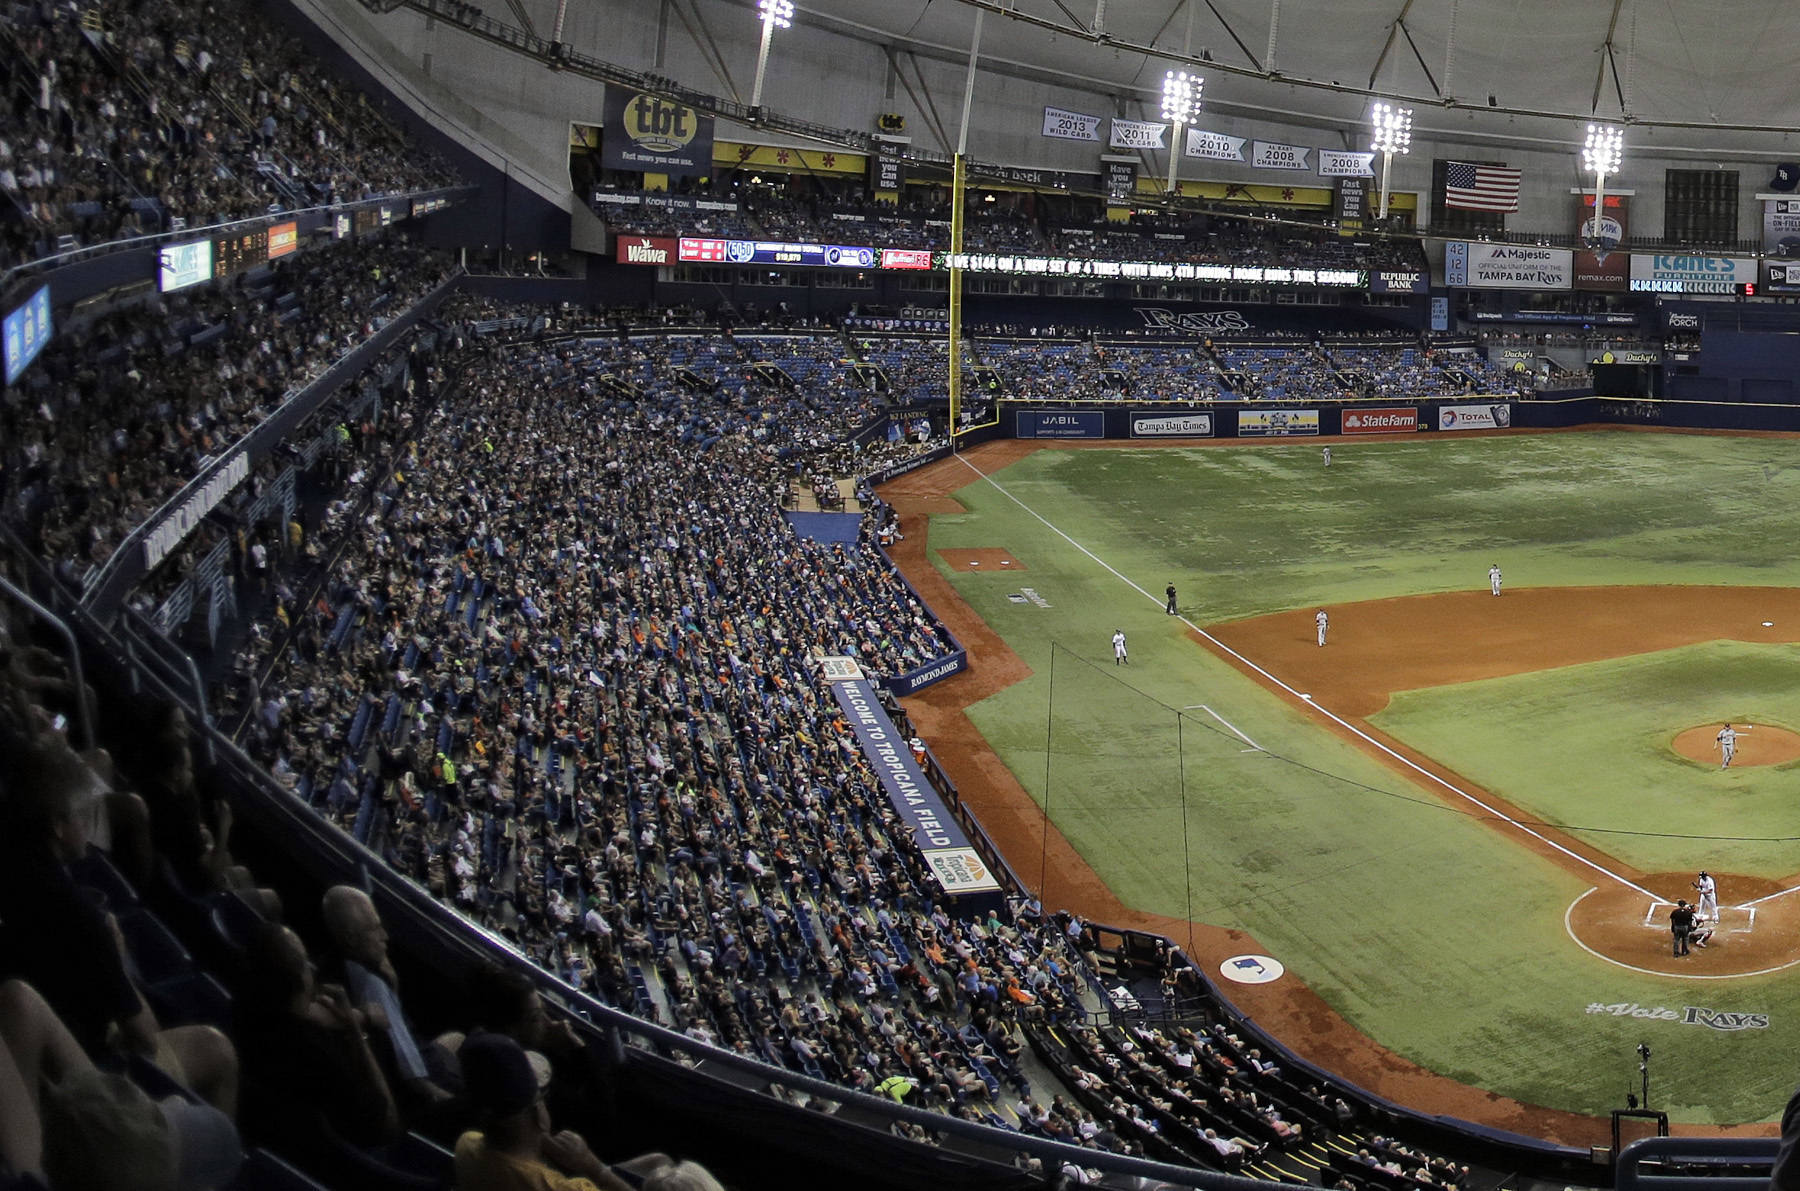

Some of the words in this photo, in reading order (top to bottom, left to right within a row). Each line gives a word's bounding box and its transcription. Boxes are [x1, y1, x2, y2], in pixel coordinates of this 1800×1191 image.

[635, 95, 688, 138] tbt
[1058, 119, 1086, 131] 2013
[1050, 127, 1069, 136] WILD
[1071, 130, 1092, 139] CARD
[1124, 129, 1151, 140] 2011
[1199, 139, 1230, 152] 2010
[622, 151, 636, 161] Fast
[655, 156, 667, 165] you
[1190, 147, 1237, 159] CHAMPIONS
[1265, 150, 1295, 161] 2008
[881, 163, 897, 173] you
[1256, 159, 1302, 168] CHAMPIONS
[1331, 158, 1360, 168] 2008
[1110, 164, 1132, 174] Have
[1322, 167, 1367, 175] CHAMPIONS
[881, 172, 897, 180] can
[1112, 174, 1129, 182] you
[880, 180, 897, 188] use.
[1342, 179, 1360, 188] Fast
[1341, 188, 1363, 196] news
[645, 196, 666, 206] Know
[667, 196, 673, 207] it
[673, 199, 691, 208] now.
[1344, 196, 1360, 204] you
[627, 245, 667, 263] Wawa
[1449, 246, 1464, 256] 42
[1508, 248, 1551, 262] Majestic
[1450, 259, 1462, 269] 12
[1478, 262, 1508, 270] OFFICIAL
[1508, 263, 1539, 271] UNIFORM
[970, 256, 996, 270] $144
[998, 257, 1014, 271] ON
[1014, 257, 1024, 271] A
[1024, 258, 1047, 272] NEW
[1049, 259, 1067, 273] SET
[1068, 260, 1082, 274] OF
[1083, 261, 1091, 274] 4
[1093, 261, 1120, 276] TIRES
[1121, 262, 1148, 277] WITH
[1233, 266, 1262, 281] HOME
[1264, 268, 1291, 282] RUNS
[1293, 269, 1316, 283] THIS
[1380, 272, 1420, 282] REPUBLIC
[1449, 273, 1463, 283] 66
[1478, 271, 1513, 281] TAMPA
[1515, 272, 1537, 282] BAY
[1578, 274, 1624, 283] remax.com
[1656, 272, 1731, 281] FURNITURE
[1387, 280, 1412, 289] BANK
[1745, 282, 1754, 296] 5
[1669, 318, 1698, 327] PORCH
[1503, 349, 1534, 359] Ducky's
[1625, 352, 1657, 363] Ducky's
[1042, 416, 1079, 426] JABIL
[1459, 413, 1491, 421] TOTAL
[1137, 421, 1165, 433] Tampa
[1166, 420, 1182, 433] Bay
[1182, 419, 1207, 431] Times
[911, 668, 940, 688] RAYMOND
[940, 660, 958, 676] JAMES
[841, 681, 878, 725] WELCOME
[866, 727, 887, 740] TO
[876, 742, 925, 806] TROPICANA
[914, 808, 951, 846] FIELD
[1681, 1005, 1770, 1032] RAYS
